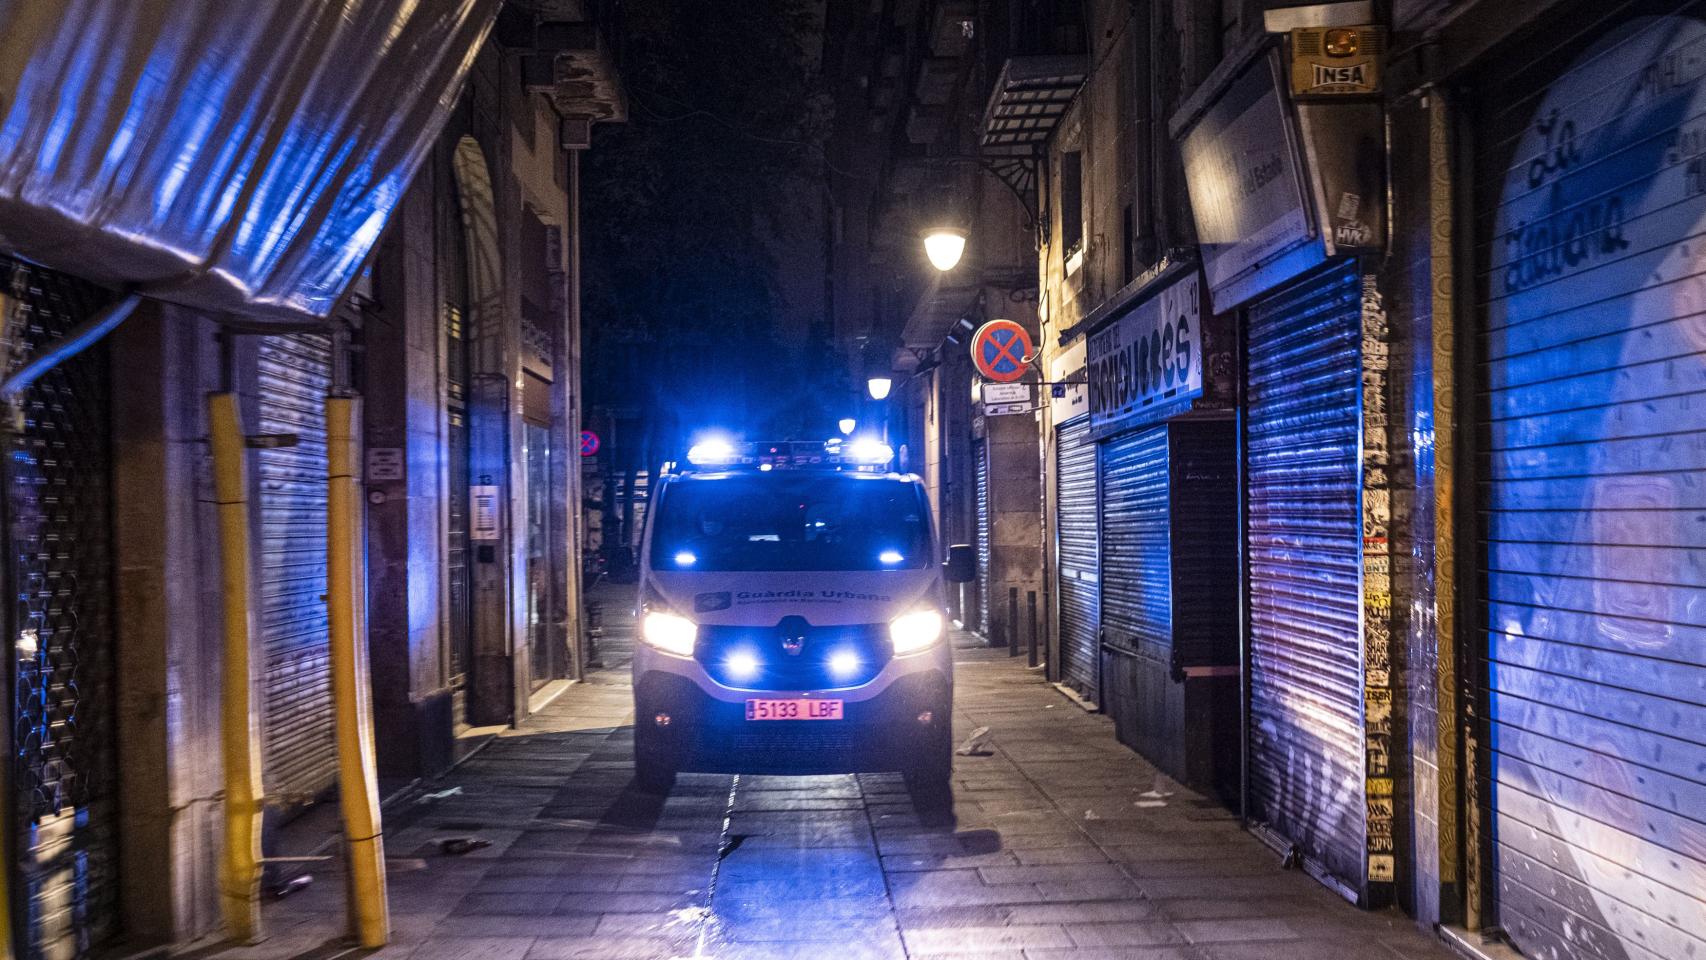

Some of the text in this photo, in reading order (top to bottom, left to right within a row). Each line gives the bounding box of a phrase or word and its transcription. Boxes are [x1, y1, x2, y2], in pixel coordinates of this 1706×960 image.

[1315, 66, 1364, 86] INSA
[821, 590, 891, 602] Urbana
[759, 702, 840, 718] 5133 LBF
